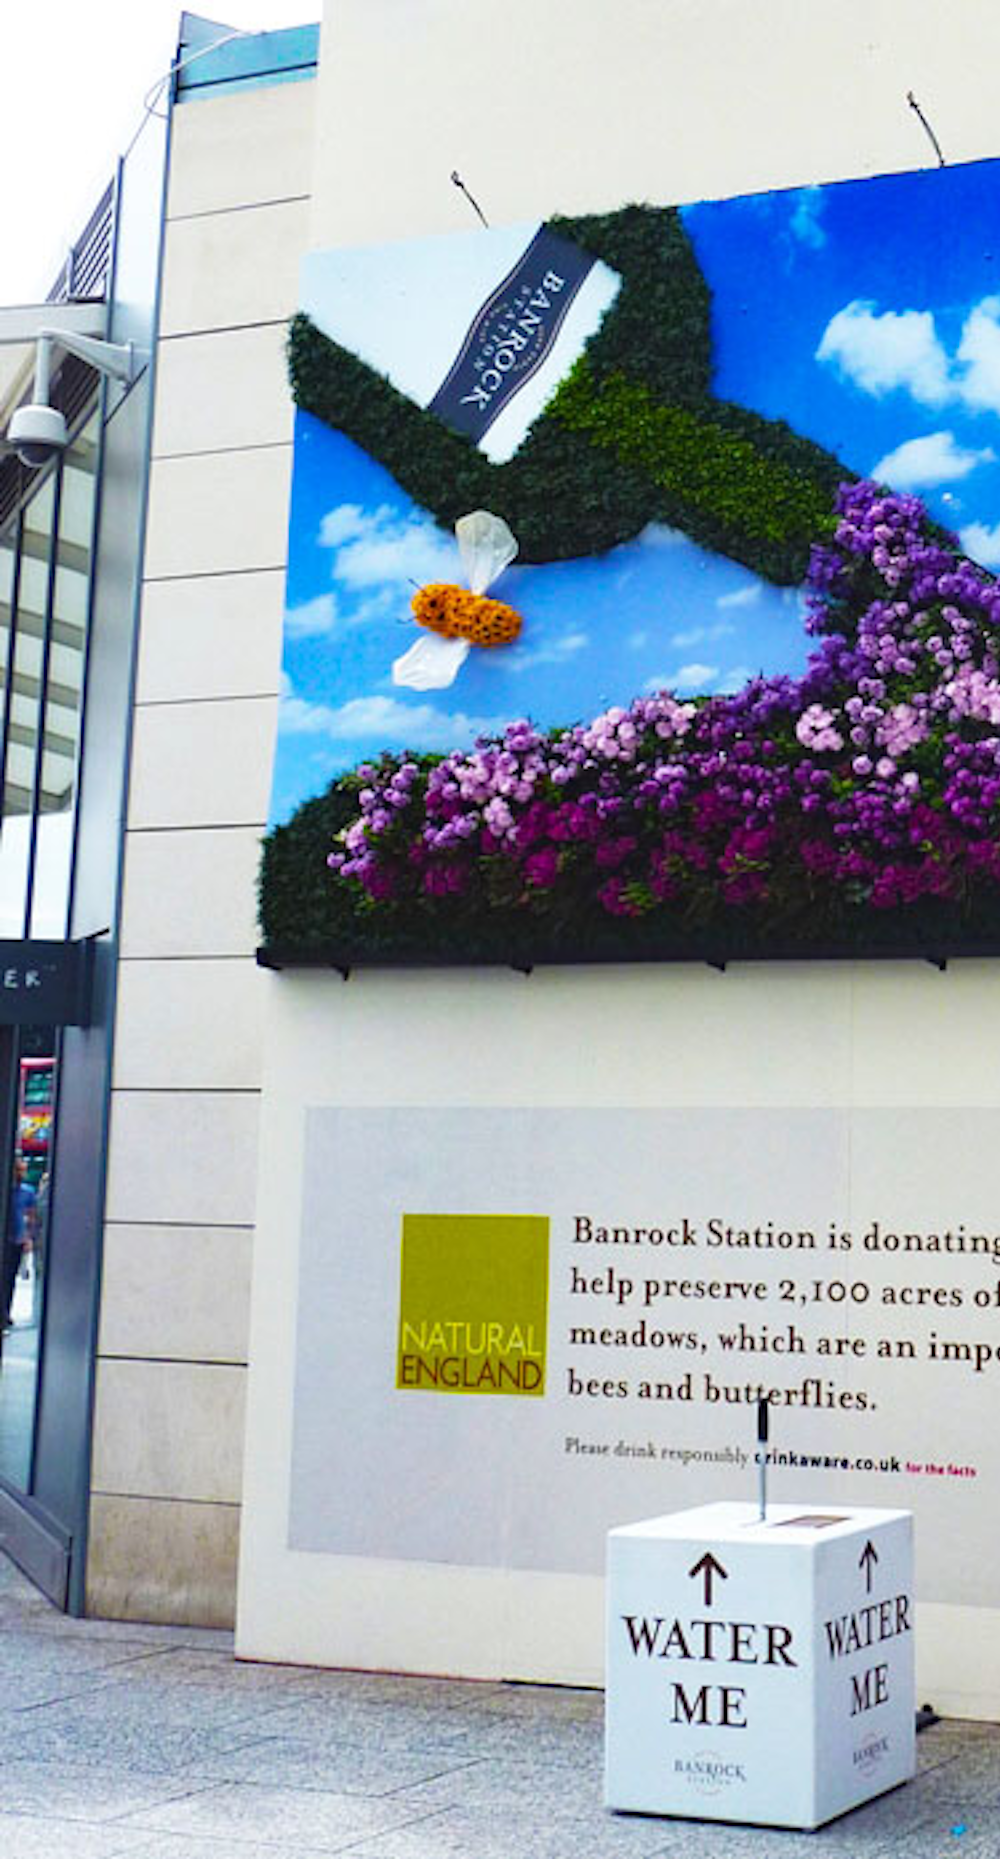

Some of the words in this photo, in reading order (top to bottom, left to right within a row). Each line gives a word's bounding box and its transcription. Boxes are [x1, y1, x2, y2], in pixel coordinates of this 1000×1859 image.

[460, 270, 566, 411] BANROCK
[572, 1216, 698, 1248] Banrock
[706, 1220, 817, 1250] Station
[828, 1222, 853, 1252] is
[570, 1266, 635, 1303] help
[644, 1274, 768, 1308] preserve
[778, 1279, 871, 1307] 2,100
[881, 1282, 964, 1309] acres
[401, 1320, 543, 1357] NATURAL
[569, 1319, 708, 1356] meadows,
[717, 1322, 807, 1356] which
[816, 1334, 867, 1358] are
[876, 1339, 918, 1360] an
[401, 1355, 543, 1391] ENGLAND
[566, 1368, 629, 1400] bees
[638, 1373, 694, 1403] and
[703, 1373, 878, 1413] butterflies.
[564, 1436, 610, 1457] Please
[612, 1439, 658, 1461] drink
[659, 1443, 749, 1470] responsibly
[925, 1463, 945, 1475] the
[949, 1464, 977, 1478] facts
[620, 1615, 799, 1668] WATER
[823, 1594, 913, 1661] WATER
[669, 1681, 748, 1729] ME
[850, 1662, 890, 1718] ME
